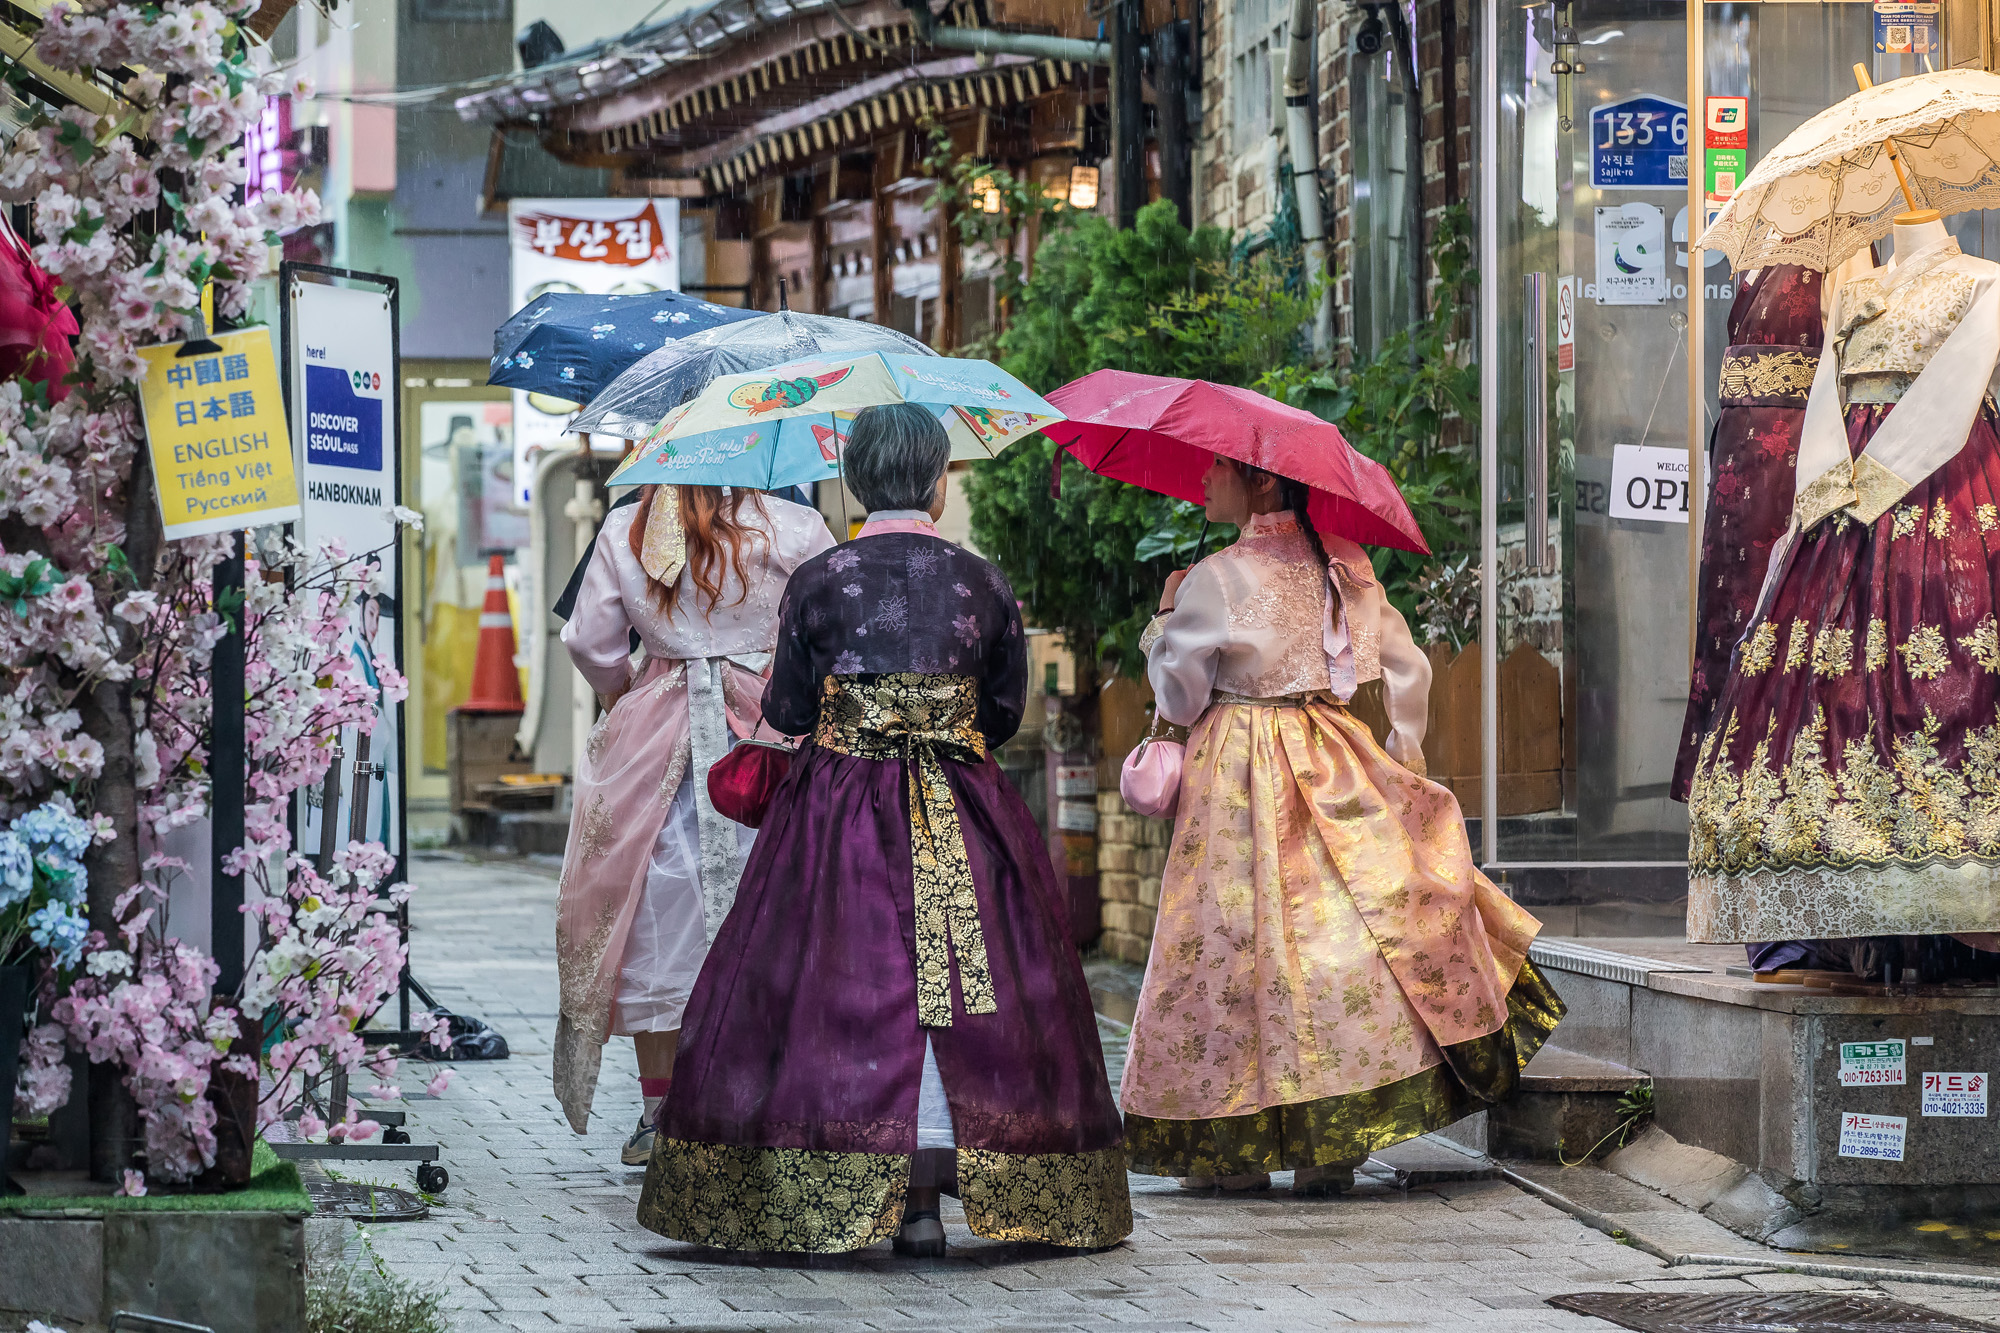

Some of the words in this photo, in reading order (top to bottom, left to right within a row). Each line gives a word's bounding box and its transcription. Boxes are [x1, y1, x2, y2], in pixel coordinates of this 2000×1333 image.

[1603, 112, 1688, 145] 133-6
[1601, 155, 1634, 167] 사직로
[1601, 168, 1634, 178] Sajik-ro
[532, 218, 652, 259] 부산집
[306, 344, 326, 360] here!
[166, 353, 249, 389] 中國語
[912, 369, 947, 386] Lulu
[939, 383, 960, 392] the
[953, 381, 1005, 401] Piggy
[174, 390, 256, 427] 日本語
[310, 412, 359, 433] DISCOVER
[174, 431, 269, 464] ENGLISH
[343, 442, 359, 455] PASS
[176, 470, 230, 490] Tiếng
[235, 461, 274, 480] Việt
[1657, 462, 1705, 474] WELCO
[186, 487, 267, 515] Русский
[308, 481, 382, 507] HANBOKNAM
[1626, 476, 1709, 512] OP
[1855, 1044, 1889, 1056] 카드
[1925, 1074, 1964, 1092] 카드
[1846, 1115, 1872, 1130] 카드
[1841, 1144, 1901, 1159] 010-2899-5262
